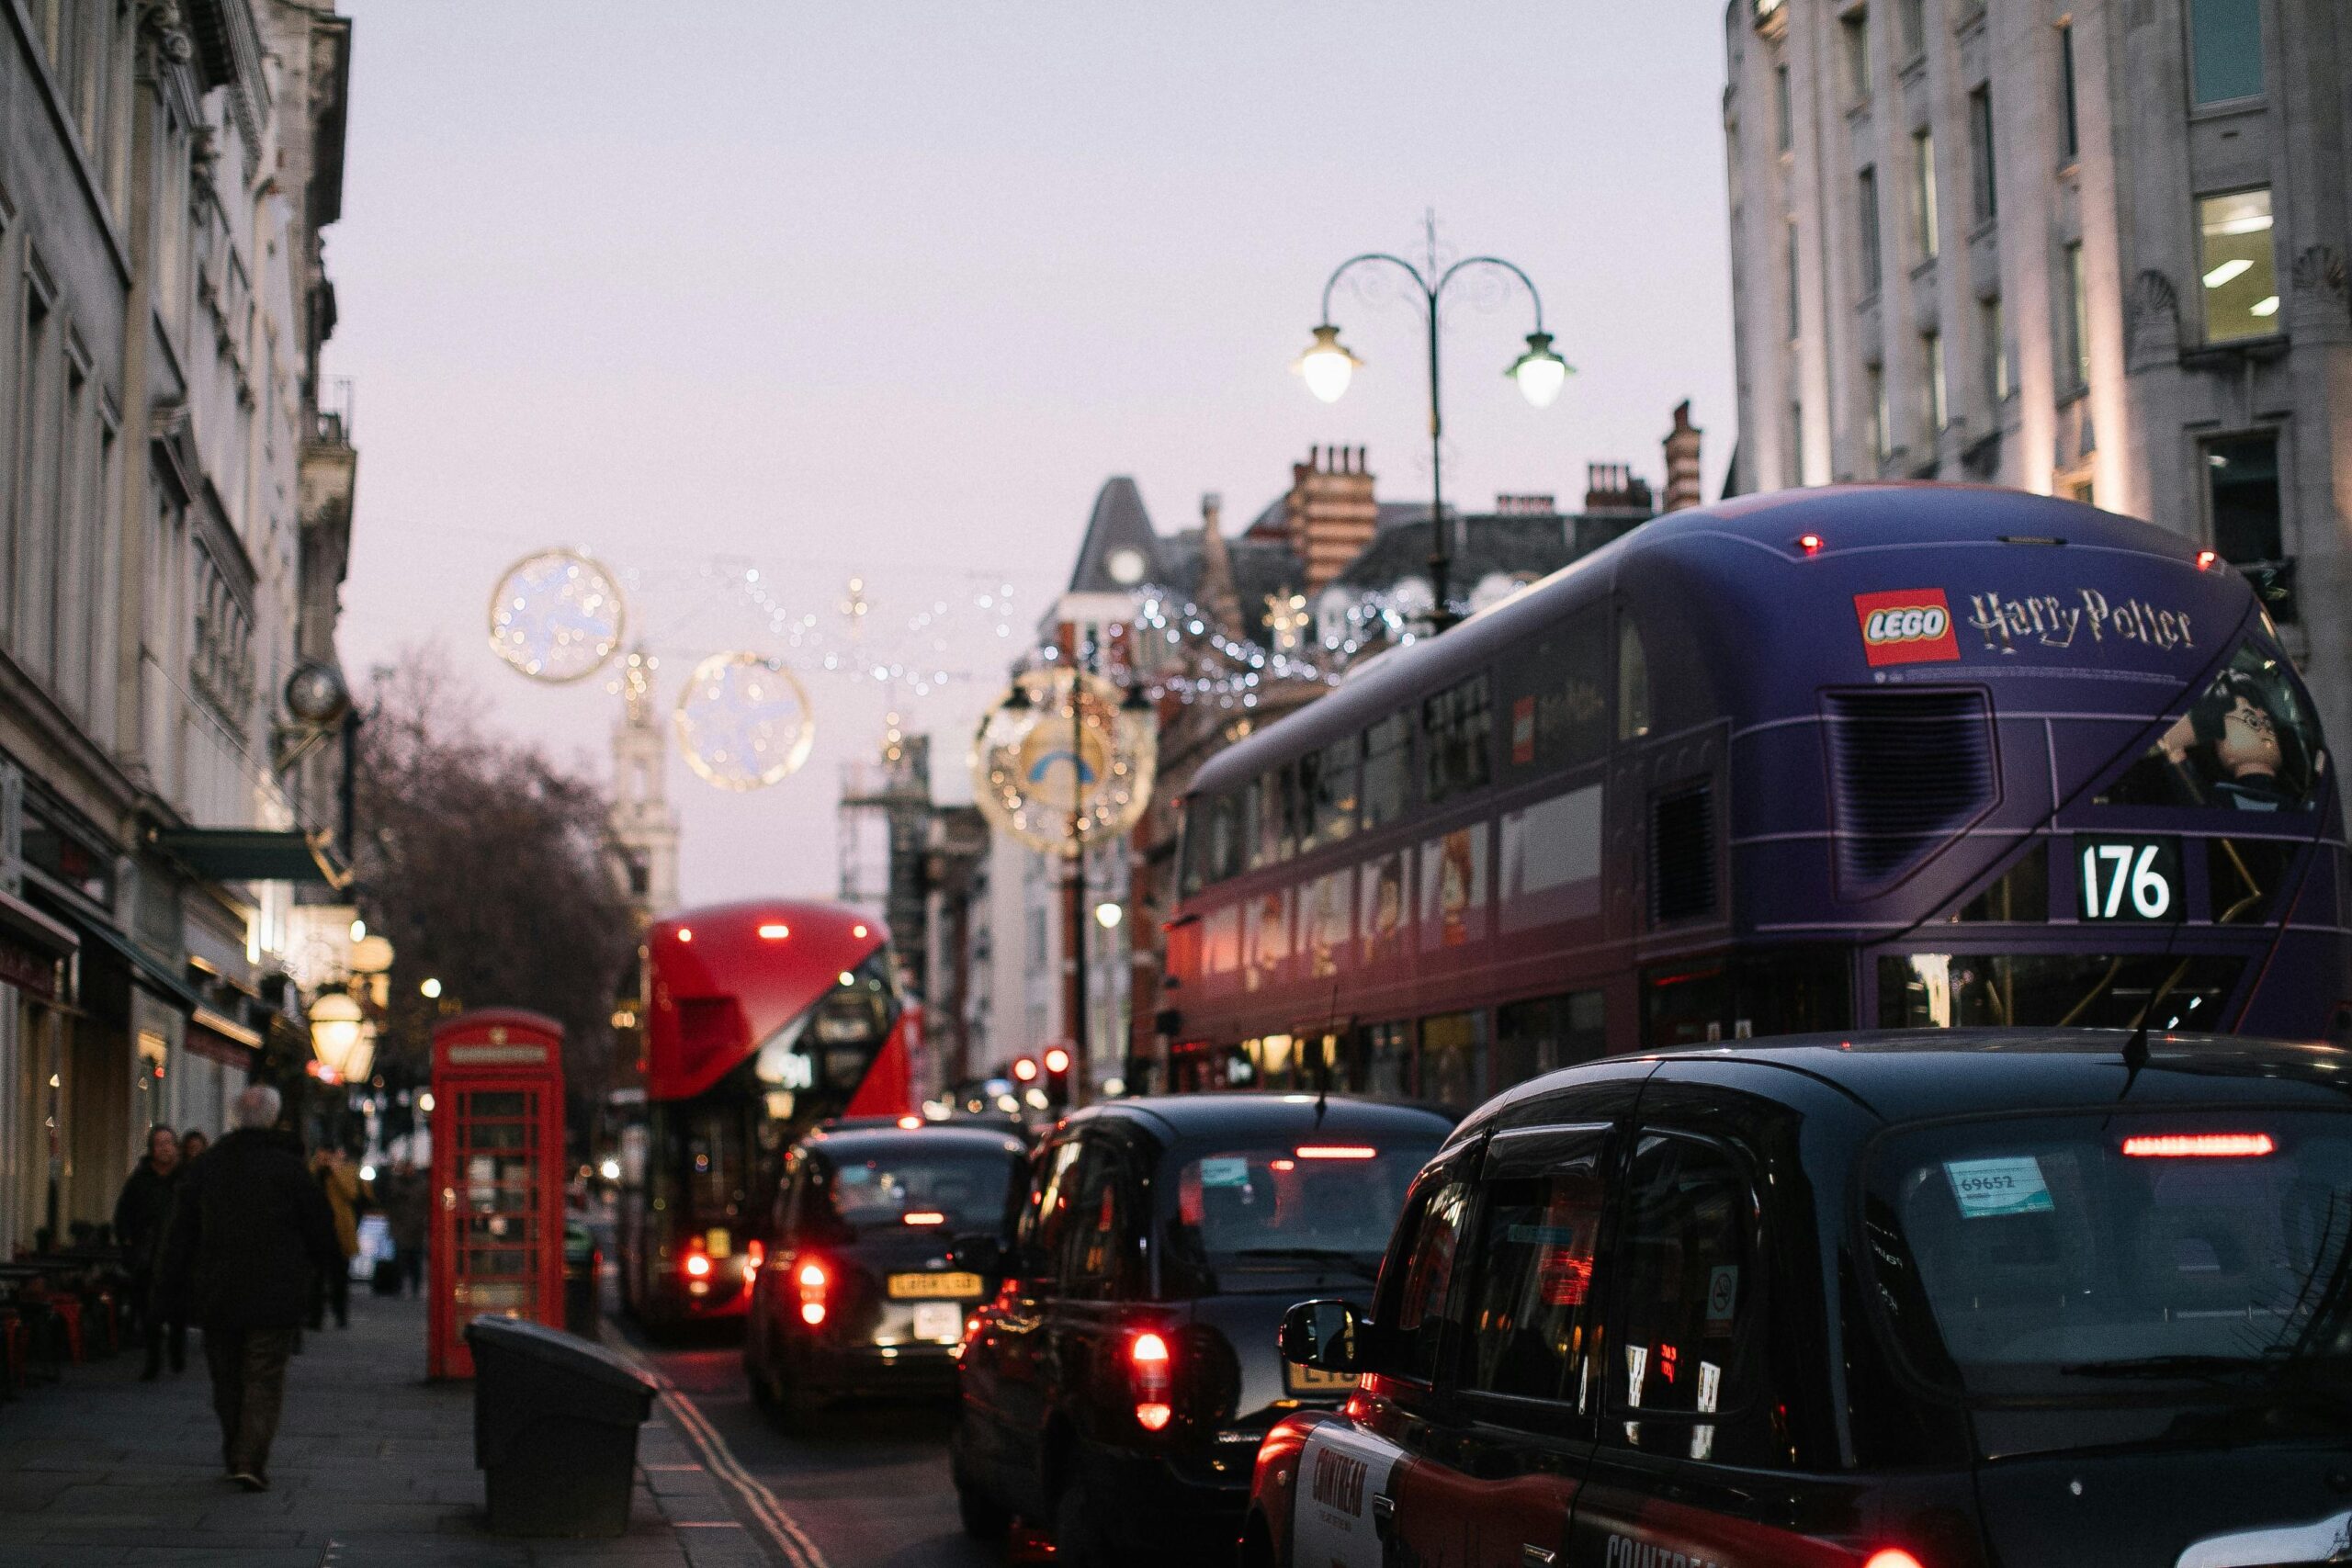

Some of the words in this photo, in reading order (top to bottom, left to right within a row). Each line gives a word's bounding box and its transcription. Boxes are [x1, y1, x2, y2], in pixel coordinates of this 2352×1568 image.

[1868, 608, 1945, 640] LEGO
[1968, 591, 2080, 655] Harry
[2077, 588, 2197, 651] Potter
[2083, 844, 2170, 919] 176
[1961, 1175, 2015, 1191] 69652
